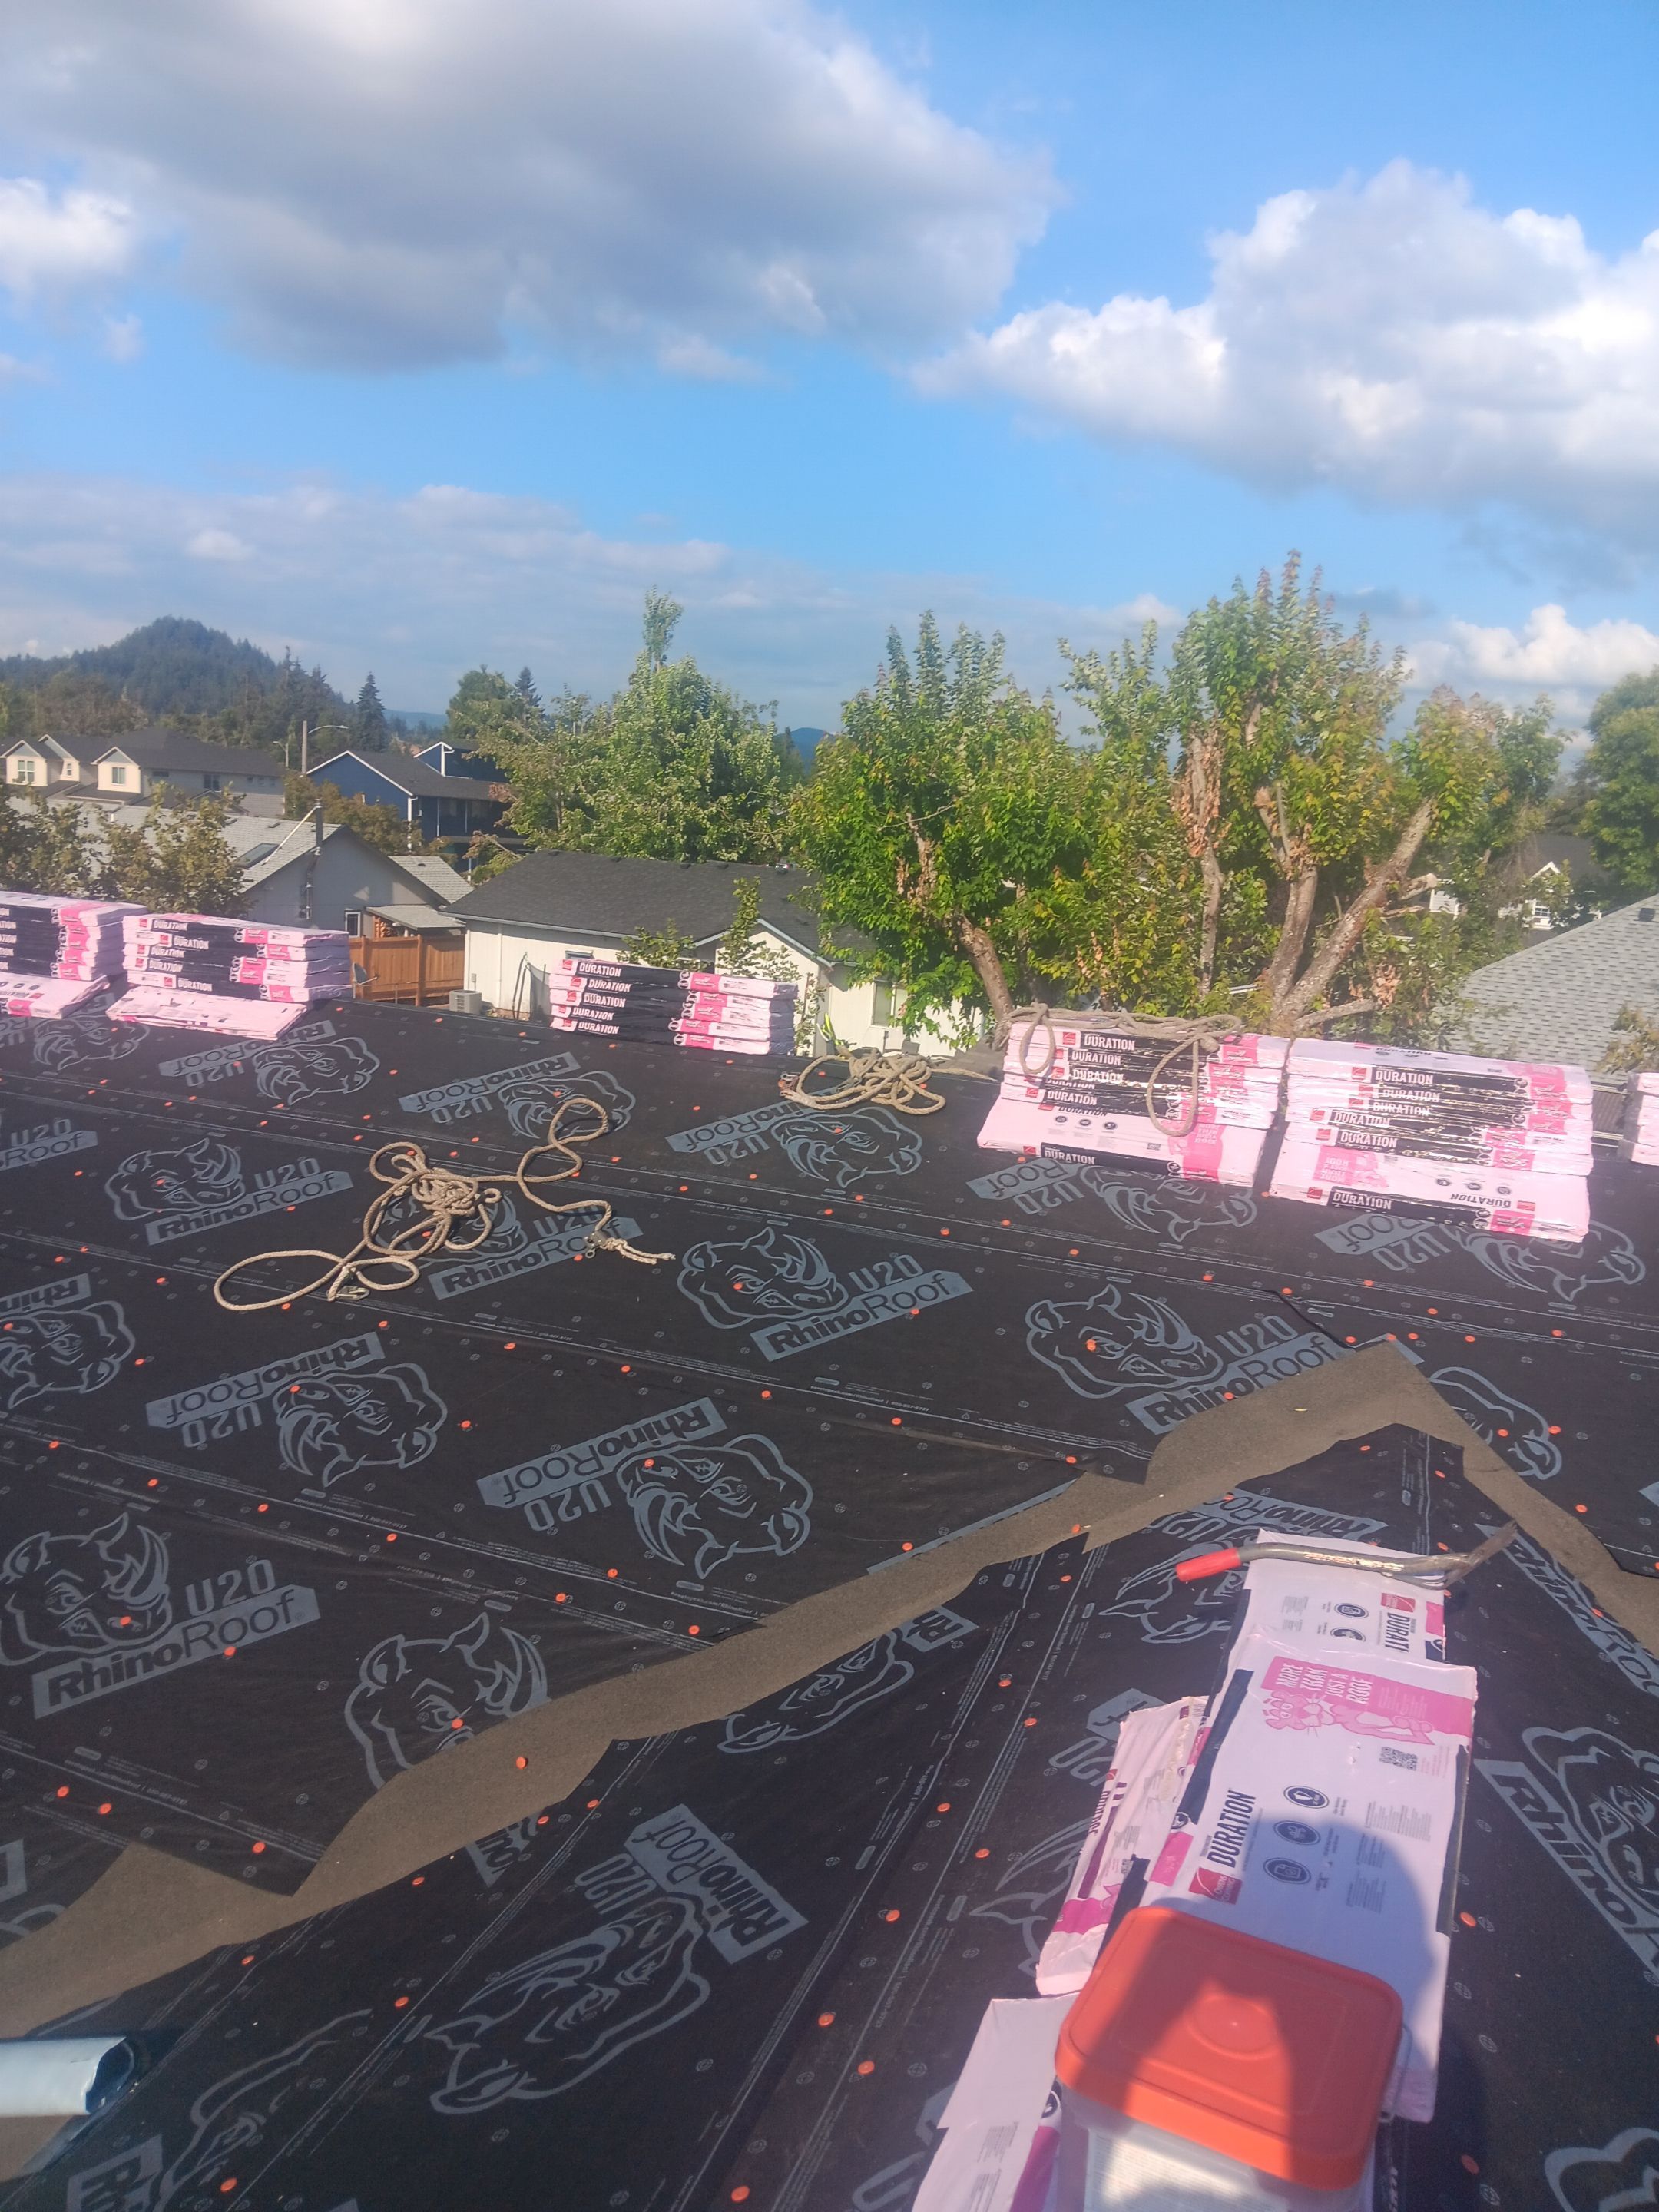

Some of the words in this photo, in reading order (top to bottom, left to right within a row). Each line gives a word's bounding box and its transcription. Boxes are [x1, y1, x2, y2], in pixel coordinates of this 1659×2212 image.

[174, 936, 209, 949] DURATION
[579, 962, 621, 977] DURATION
[177, 979, 212, 992] DURATION
[588, 979, 632, 992] DURATION
[573, 1007, 614, 1021] DURATION
[584, 995, 626, 1008] DURATION
[578, 1022, 619, 1034] DURATION
[1084, 1035, 1136, 1051] DURATION
[1071, 1051, 1121, 1065] DURATION
[416, 1055, 569, 1111] RhinoRoof
[1073, 1069, 1124, 1084] DURATION
[1376, 1070, 1434, 1085] DURATION
[1047, 1091, 1098, 1105] DURATION
[1373, 1102, 1432, 1116] DURATION
[1382, 1089, 1442, 1102] DURATION
[430, 1096, 493, 1124] U20
[1334, 1111, 1391, 1128] DURATION
[11, 1119, 71, 1147] U20
[1340, 1132, 1398, 1148] DURATION
[0, 1132, 83, 1167] Roof
[704, 1135, 770, 1164] U20
[1045, 1150, 1095, 1164] DURATION
[254, 1157, 321, 1190] U20
[155, 1172, 335, 1238] RhinoRoof
[1013, 1181, 1085, 1214] U20
[1333, 1192, 1392, 1210] DURATION
[1450, 1193, 1512, 1207] DURATION
[443, 1219, 622, 1292] RhinoRof
[1371, 1232, 1451, 1271] U20
[849, 1254, 923, 1293] U20
[766, 1273, 952, 1353] RhinoRoof
[1215, 1315, 1298, 1359] U20
[166, 1337, 369, 1425] RhinoRoof
[1144, 1335, 1337, 1428] RhinoRoof
[182, 1402, 262, 1448] U20
[502, 1406, 710, 1505] RhinoRoof
[524, 1479, 611, 1531] U20
[185, 1560, 276, 1616] U20
[1385, 1613, 1410, 1652] DURATI
[48, 1590, 295, 1707] RhinoRoof
[1276, 1663, 1303, 1687] MORE
[1300, 1667, 1327, 1690] THAN
[1325, 1679, 1346, 1697] JUST
[1346, 1677, 1373, 1704] ROOF
[1207, 1790, 1256, 1868] DURATION
[575, 1853, 657, 1915] U20
[631, 1819, 790, 1946] RhinoRoof
